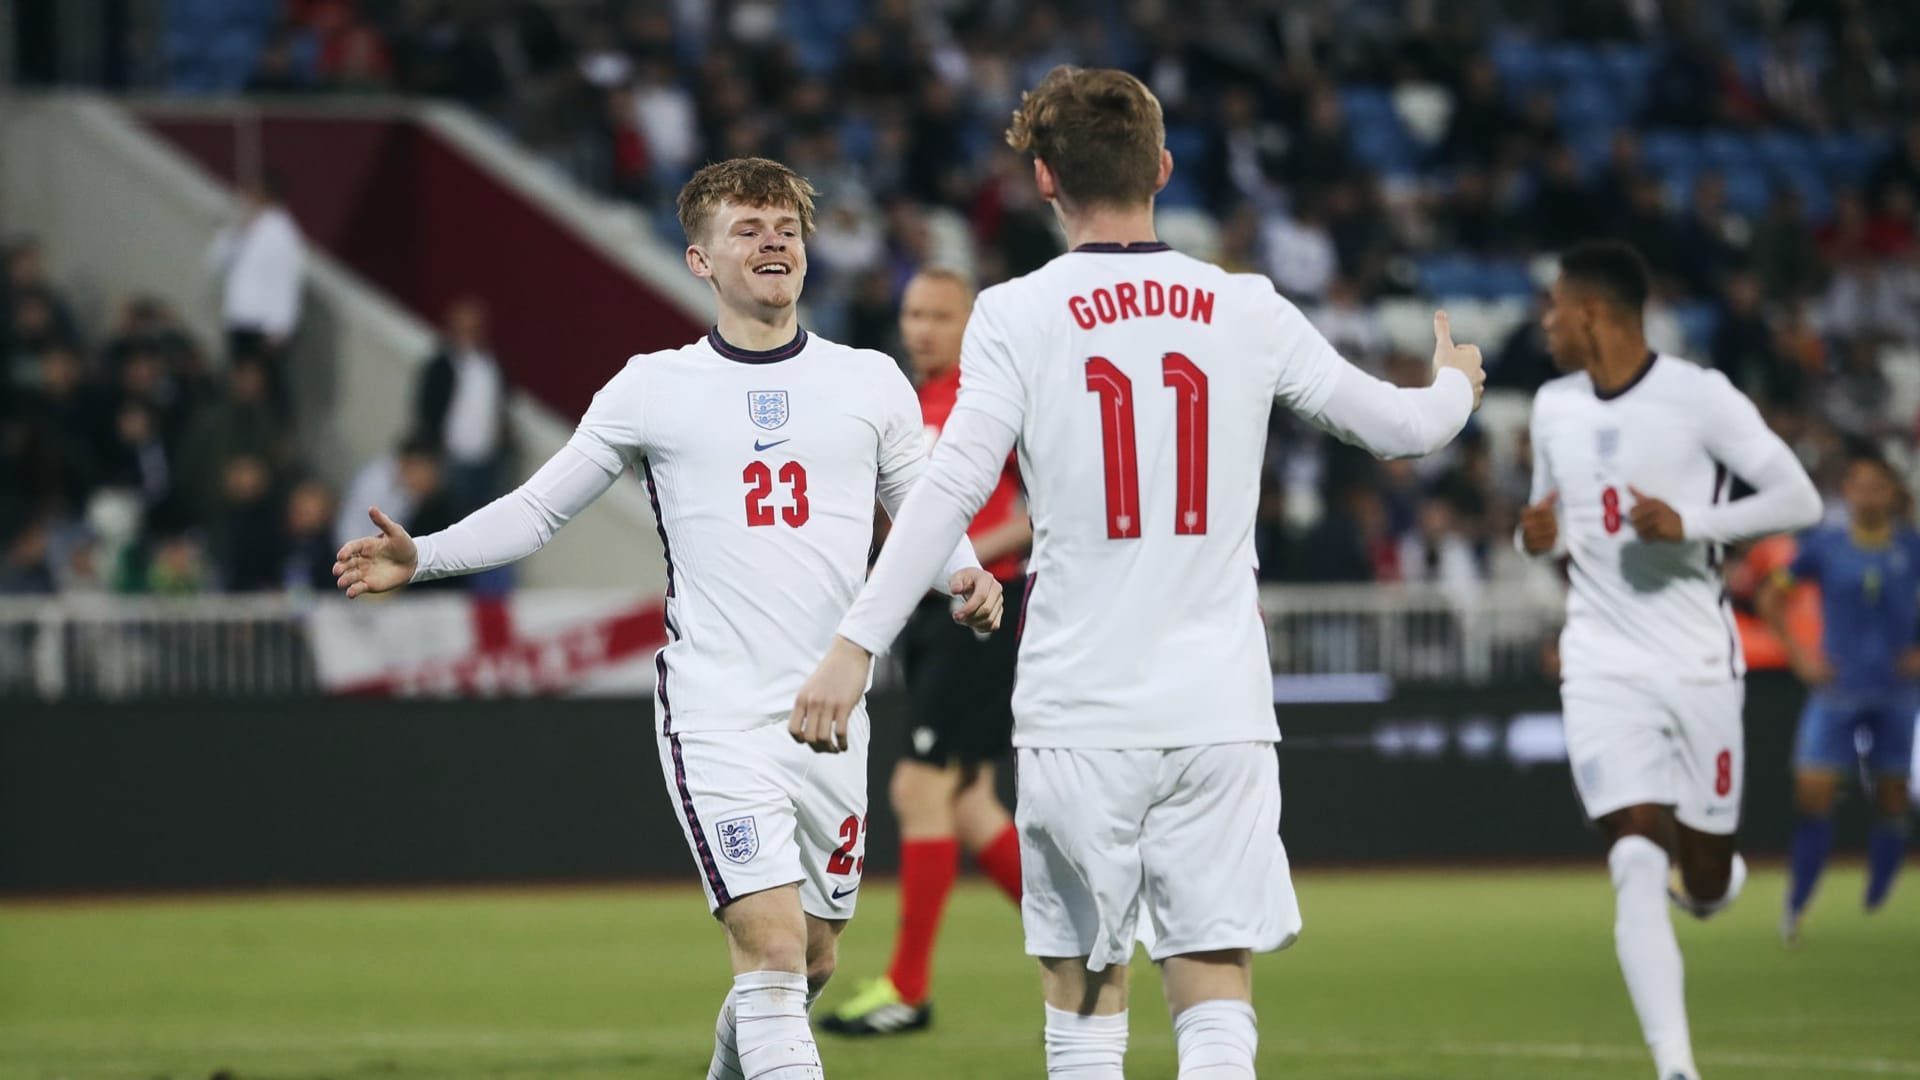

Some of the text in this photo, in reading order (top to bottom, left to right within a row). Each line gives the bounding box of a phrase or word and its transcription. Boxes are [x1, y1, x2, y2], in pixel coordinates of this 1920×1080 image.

[1068, 280, 1215, 330] GORDON
[1085, 352, 1208, 539] 11
[743, 460, 809, 528] 23
[1602, 486, 1621, 534] 8
[1715, 748, 1731, 797] 8
[826, 814, 867, 875] 2
